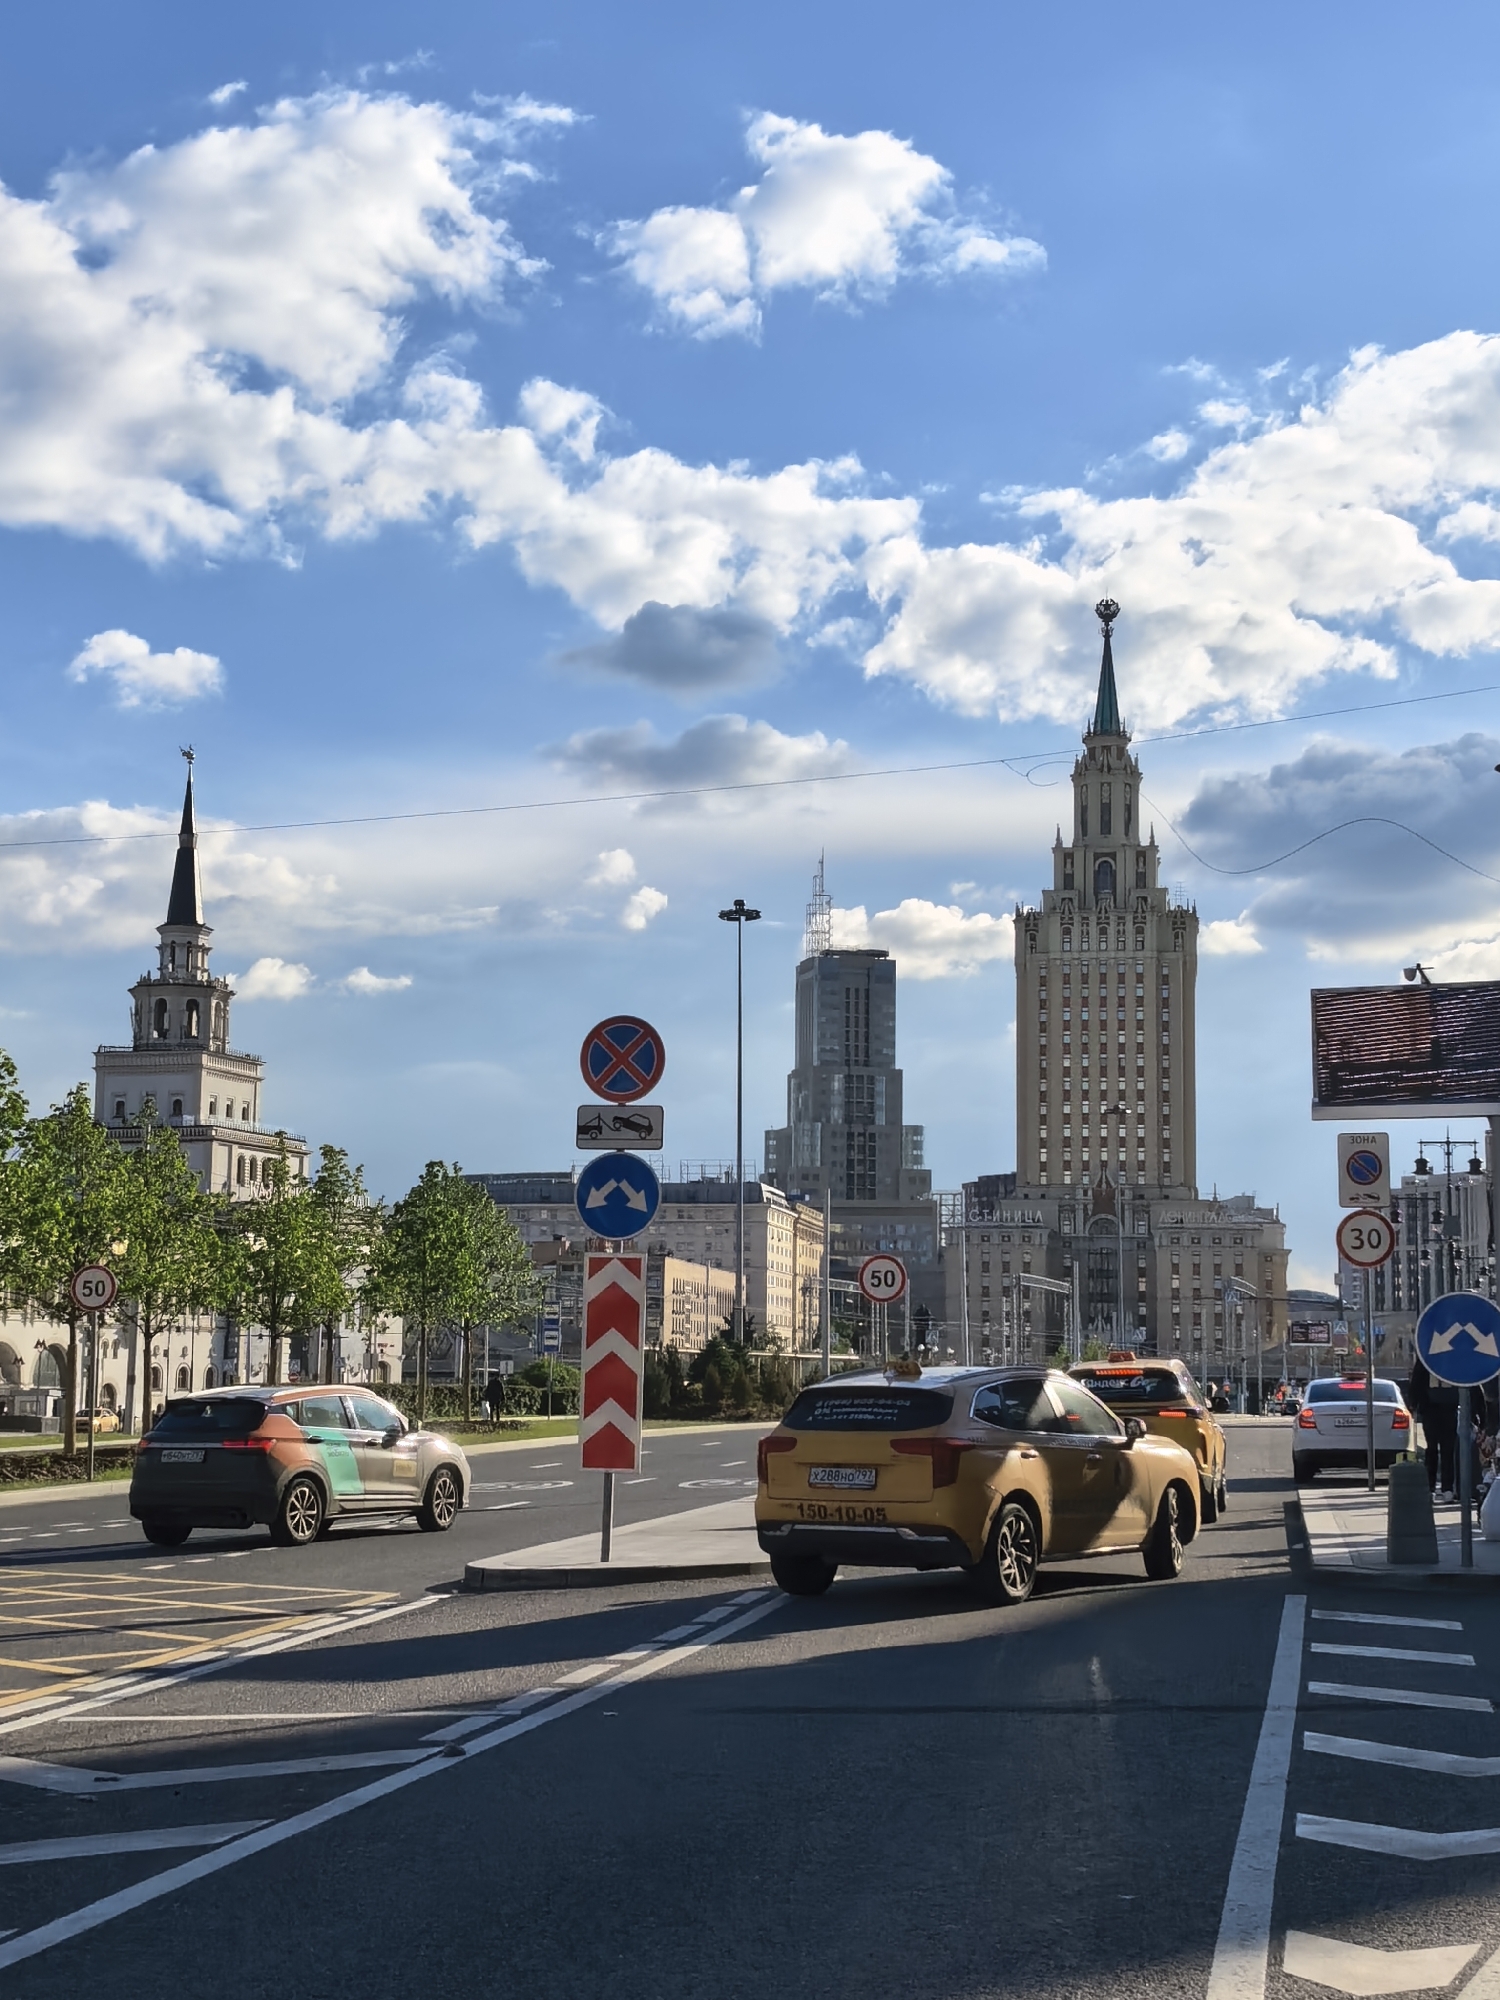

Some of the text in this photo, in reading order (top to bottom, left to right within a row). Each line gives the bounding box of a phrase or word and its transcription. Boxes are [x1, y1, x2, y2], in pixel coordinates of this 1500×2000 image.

[1350, 1135, 1377, 1145] ЗОНА
[969, 1209, 1043, 1223] СТИНИЦА
[1350, 1228, 1382, 1250] 30
[871, 1269, 896, 1288] 50
[82, 1280, 106, 1298] 50
